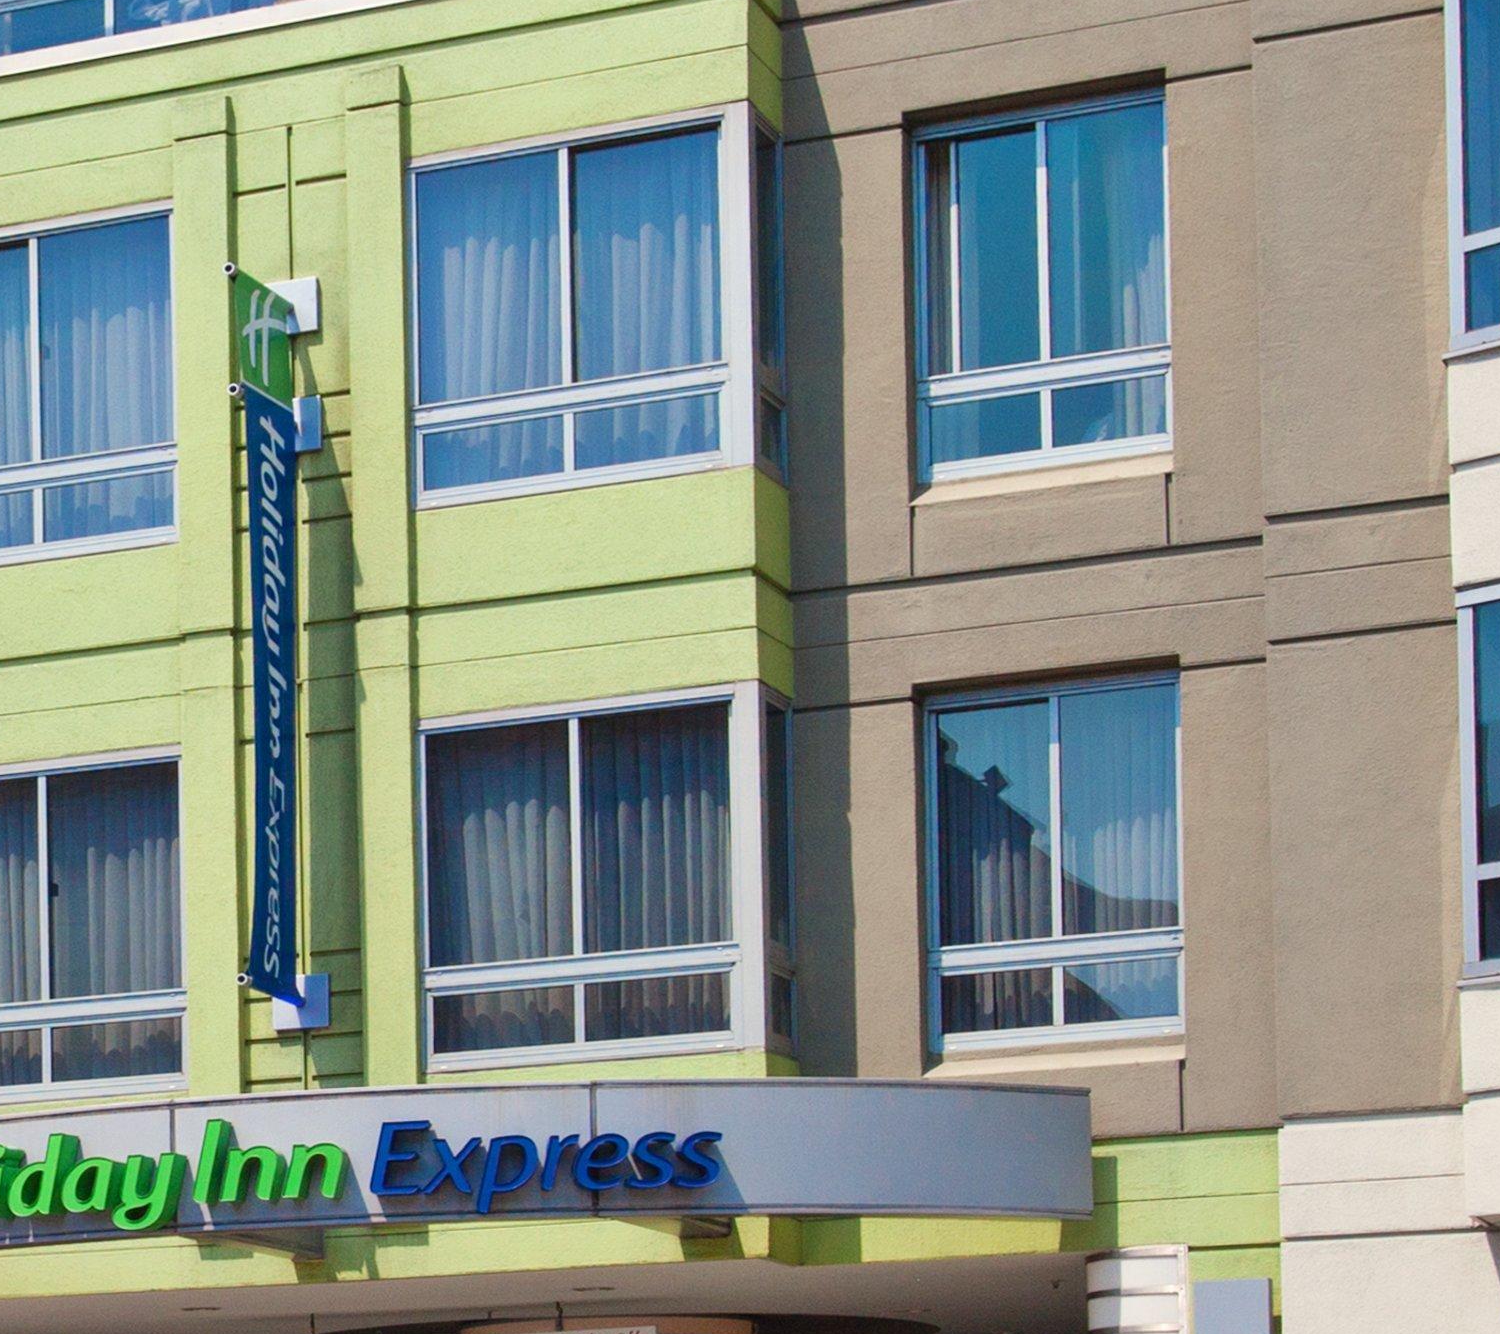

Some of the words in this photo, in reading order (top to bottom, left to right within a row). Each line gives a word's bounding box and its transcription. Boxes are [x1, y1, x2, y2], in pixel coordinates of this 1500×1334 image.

[259, 415, 285, 656] Holiday
[268, 662, 287, 759] Inn
[264, 767, 285, 979] Express
[193, 1118, 346, 1205] Inn
[370, 1120, 723, 1214] Express
